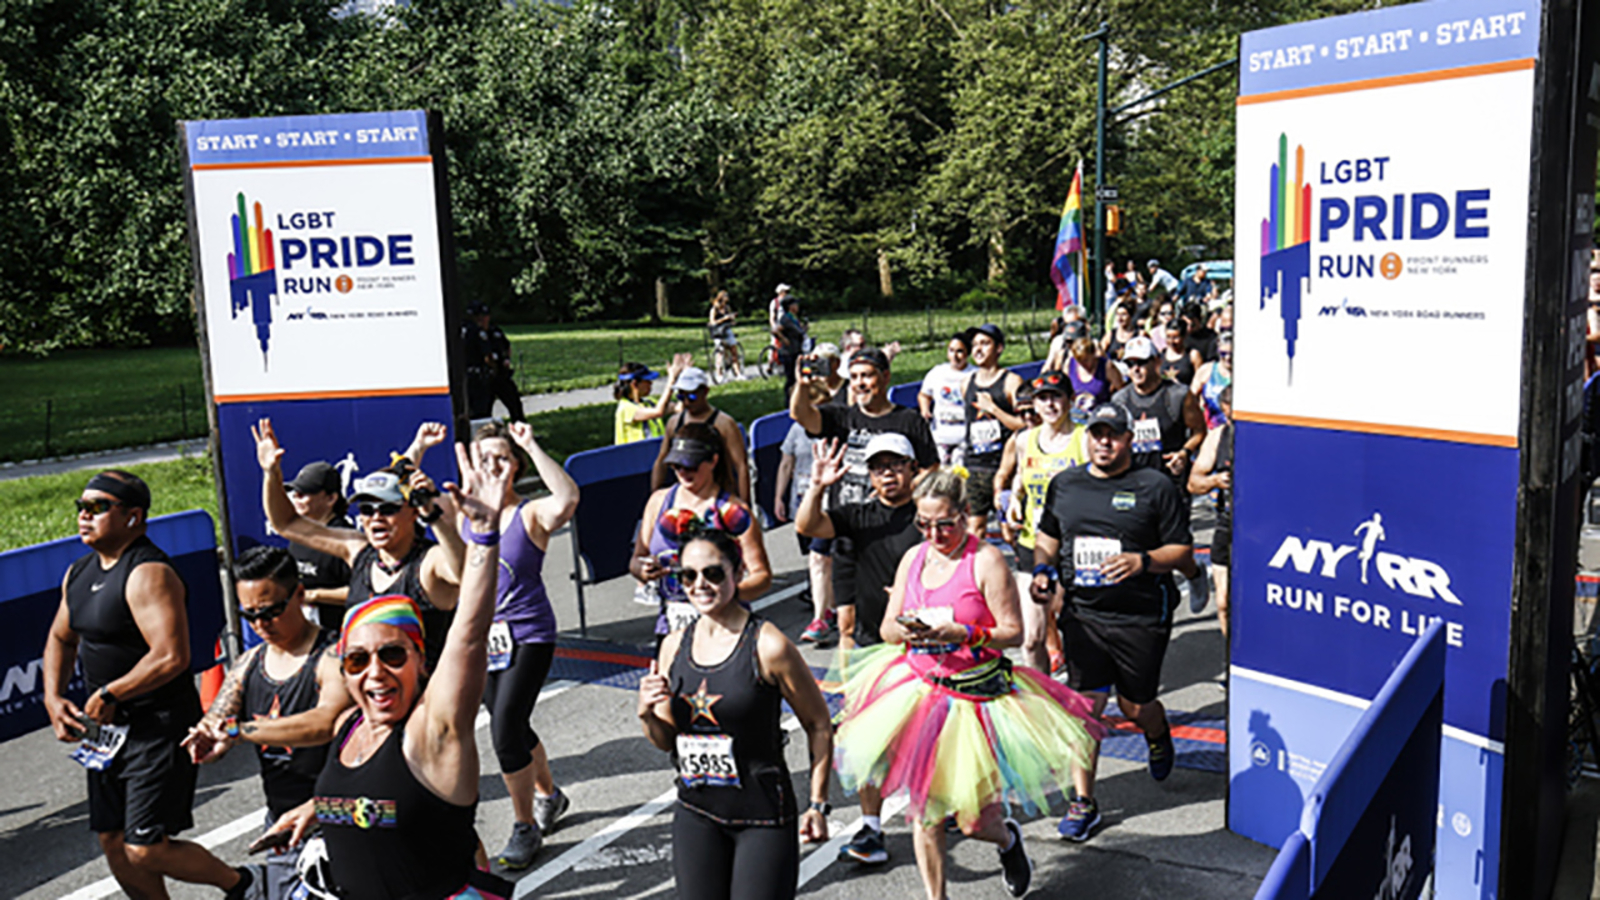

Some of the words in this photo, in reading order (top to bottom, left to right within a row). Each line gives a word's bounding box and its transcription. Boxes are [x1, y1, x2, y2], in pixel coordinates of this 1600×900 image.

[1249, 44, 1315, 73] START
[1335, 29, 1413, 60] START
[1436, 11, 1526, 46] START
[196, 134, 259, 151] START
[276, 130, 339, 148] START
[356, 126, 419, 144] START
[1320, 156, 1390, 185] LGBT
[277, 211, 336, 230] LGBT
[1319, 188, 1491, 243] PRIDE
[279, 234, 415, 270] PRIDE
[1318, 253, 1375, 279] RUN
[284, 276, 332, 294] RUN
[1266, 582, 1324, 615] RUN
[1334, 595, 1391, 630] FOR
[1401, 610, 1464, 648] LIE
